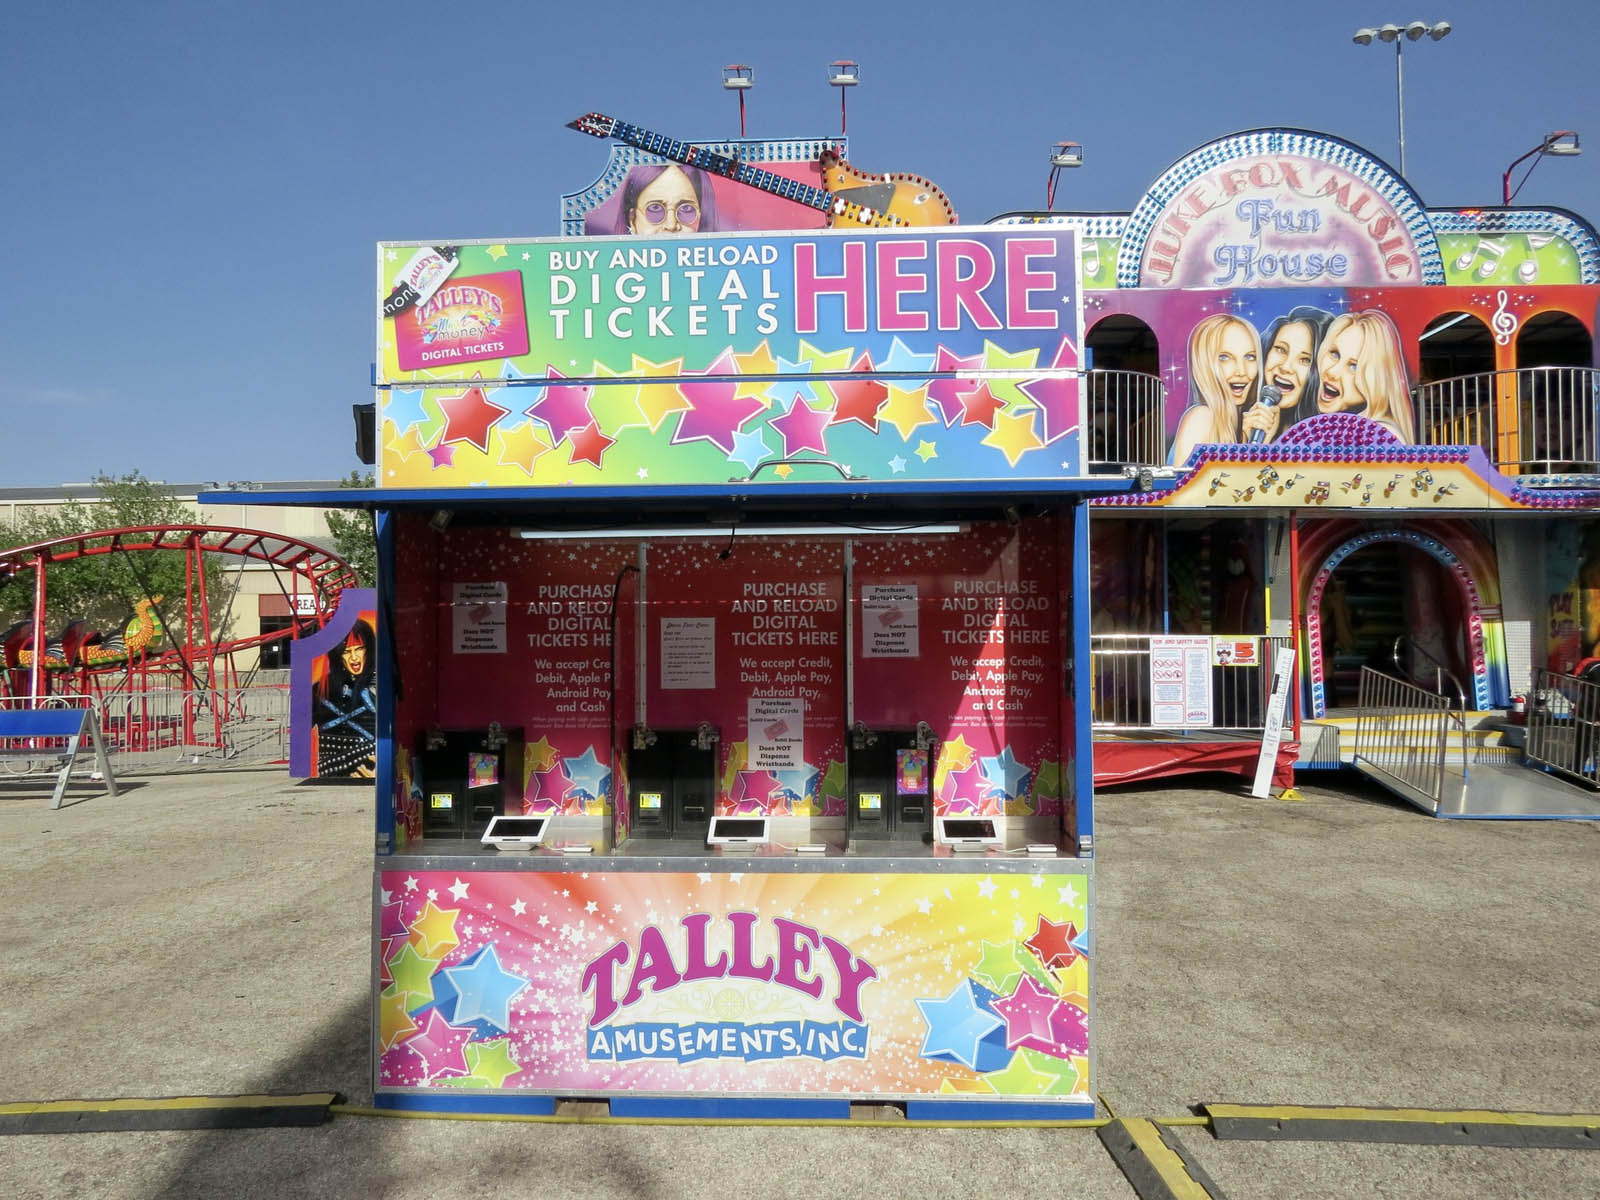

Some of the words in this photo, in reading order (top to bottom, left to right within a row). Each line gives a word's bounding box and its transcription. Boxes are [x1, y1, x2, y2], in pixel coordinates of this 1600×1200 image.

[1235, 199, 1321, 237] Fun
[1147, 186, 1217, 285] JUKE
[1315, 174, 1412, 280] MUSIC
[549, 250, 600, 270] BUY
[608, 248, 668, 268] AND
[677, 245, 779, 267] RELOAD
[1213, 243, 1347, 286] House
[550, 269, 780, 305] DIGITAL
[794, 238, 1059, 333] HERE
[415, 286, 503, 325] TALLEY'S
[549, 302, 779, 339] TICKETS
[438, 327, 485, 341] money
[421, 348, 462, 361] DIGITAL
[464, 342, 505, 355] TICKETS
[743, 582, 826, 596] PURCHASE
[953, 580, 1038, 594] PURCHASE
[527, 601, 562, 615] AND
[568, 600, 613, 615] RELO
[731, 599, 768, 613] AND
[773, 599, 838, 613] RELOAD
[942, 597, 979, 611] AND
[984, 596, 1050, 611] RELOAD
[548, 617, 612, 631] DIGITAL
[752, 615, 817, 629] DIGITAL
[963, 613, 1028, 627] DIGITAL
[527, 633, 588, 647] TICKETS
[732, 631, 794, 646] TICKETS
[799, 631, 838, 645] HERE
[942, 630, 1005, 644] TICKETS
[1010, 629, 1050, 644] HERE
[1235, 642, 1254, 658] 5
[534, 658, 553, 669] We
[556, 659, 589, 671] accept
[740, 657, 758, 669] We
[761, 658, 795, 671] accept
[798, 656, 833, 669] Credit,
[951, 655, 969, 667] We
[972, 656, 1006, 670] accept
[1010, 655, 1046, 669] Credit,
[535, 672, 565, 684] Debit,
[569, 672, 601, 685] Apple
[741, 671, 771, 684] Debit,
[775, 671, 807, 685] Apple
[811, 671, 832, 685] Pay,
[986, 670, 1018, 684] Apple
[1021, 670, 1045, 684] Pay,
[547, 686, 589, 698] Android
[752, 685, 795, 698] Android
[799, 686, 821, 700] Pay,
[963, 684, 1006, 696] Android
[1010, 685, 1033, 699] Pay,
[556, 700, 577, 712] and
[580, 700, 606, 712] Cash
[972, 699, 993, 711] and
[997, 699, 1023, 711] Cash
[581, 912, 879, 1027] TALLEY
[591, 1027, 802, 1055] AMUSEMENTS,
[806, 1027, 865, 1055] INC.
